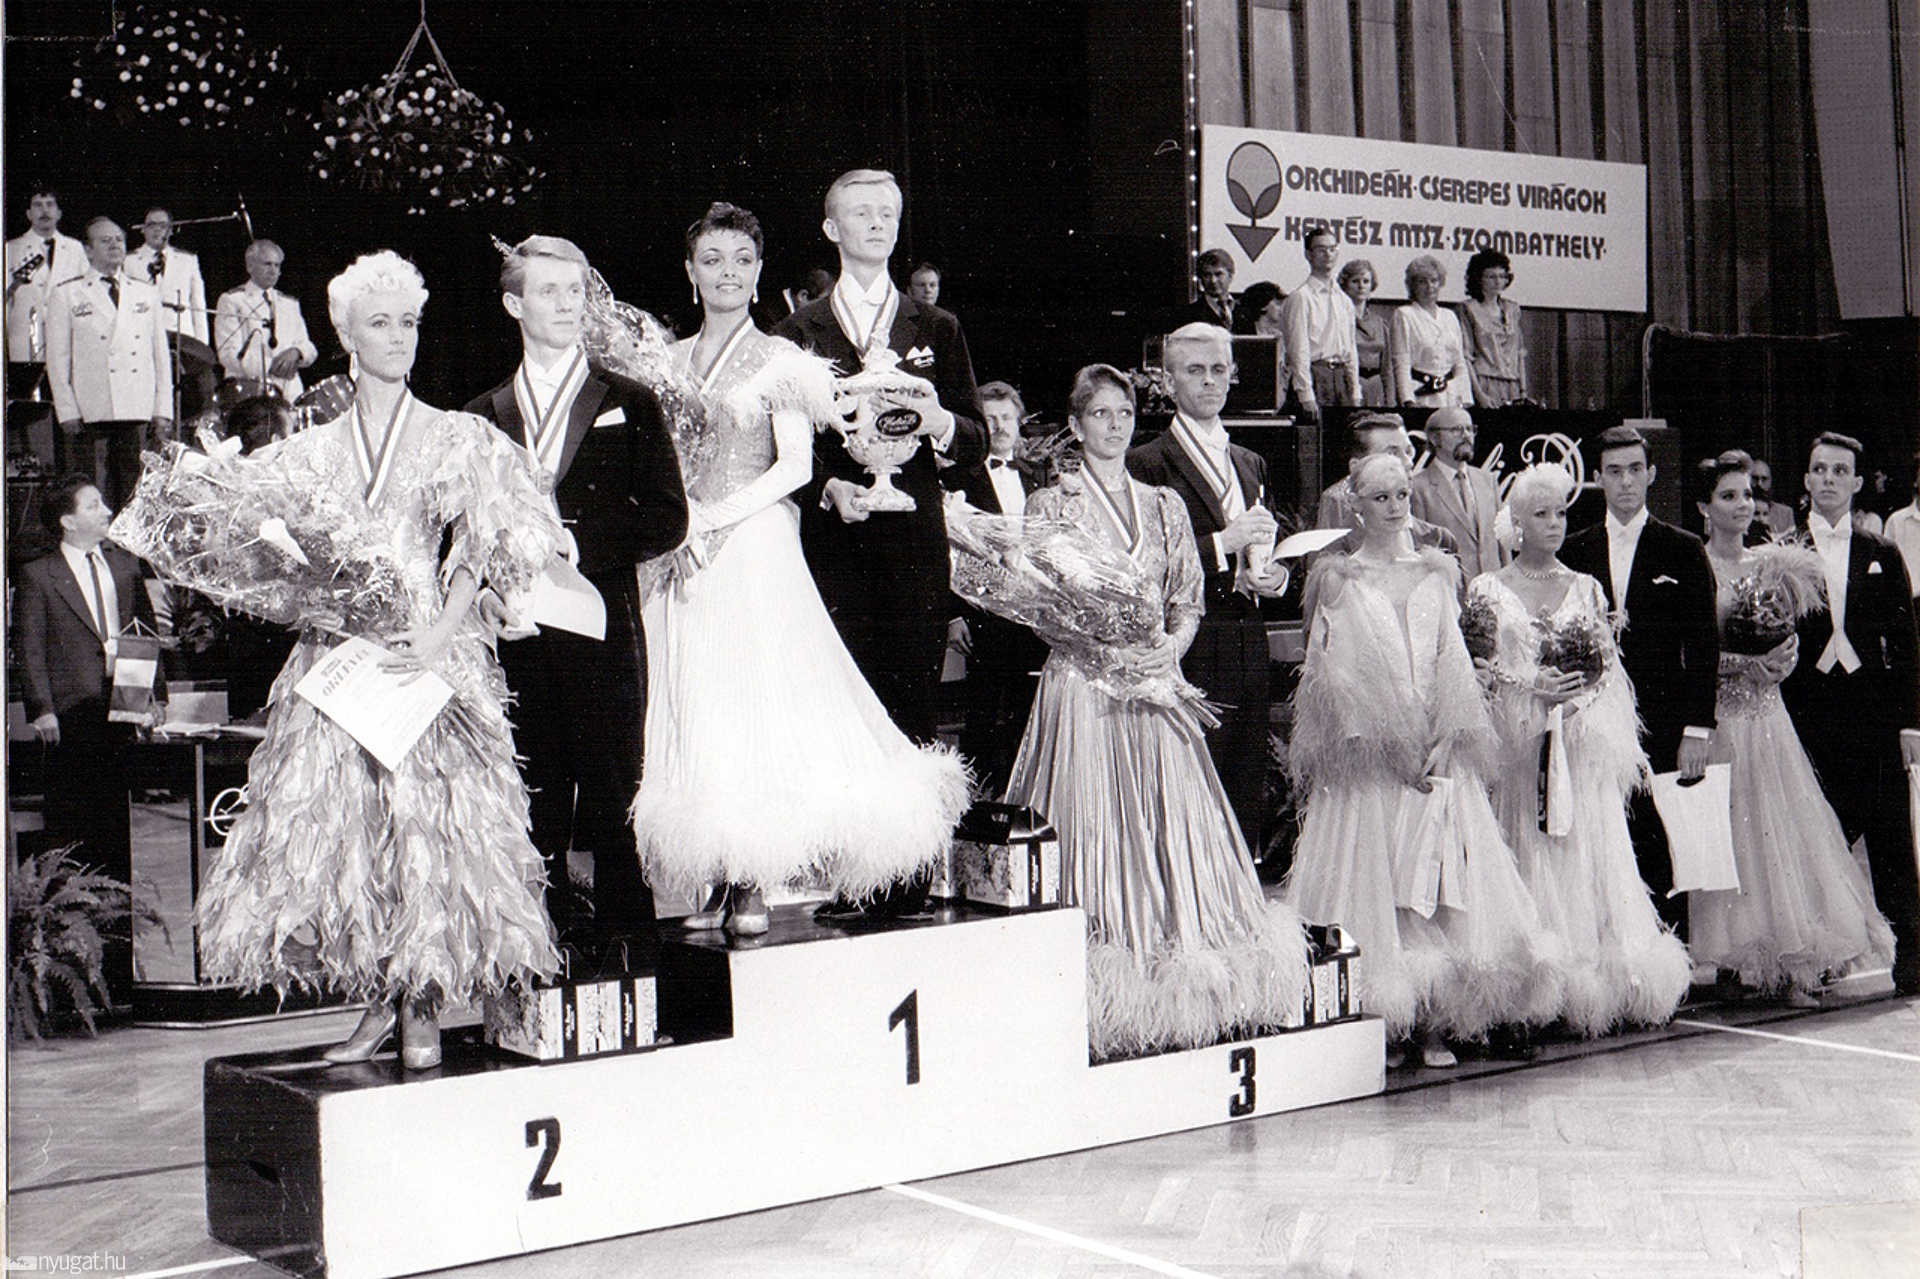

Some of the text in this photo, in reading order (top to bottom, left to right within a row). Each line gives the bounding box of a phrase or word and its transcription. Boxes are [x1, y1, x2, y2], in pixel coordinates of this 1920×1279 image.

[1419, 175, 1511, 206] CSEREPES
[1517, 183, 1607, 214] VIRÁGOK
[1389, 222, 1444, 249] MTSZ
[888, 988, 920, 1085] 1
[1229, 1046, 1257, 1118] 3
[524, 1117, 563, 1200] 2
